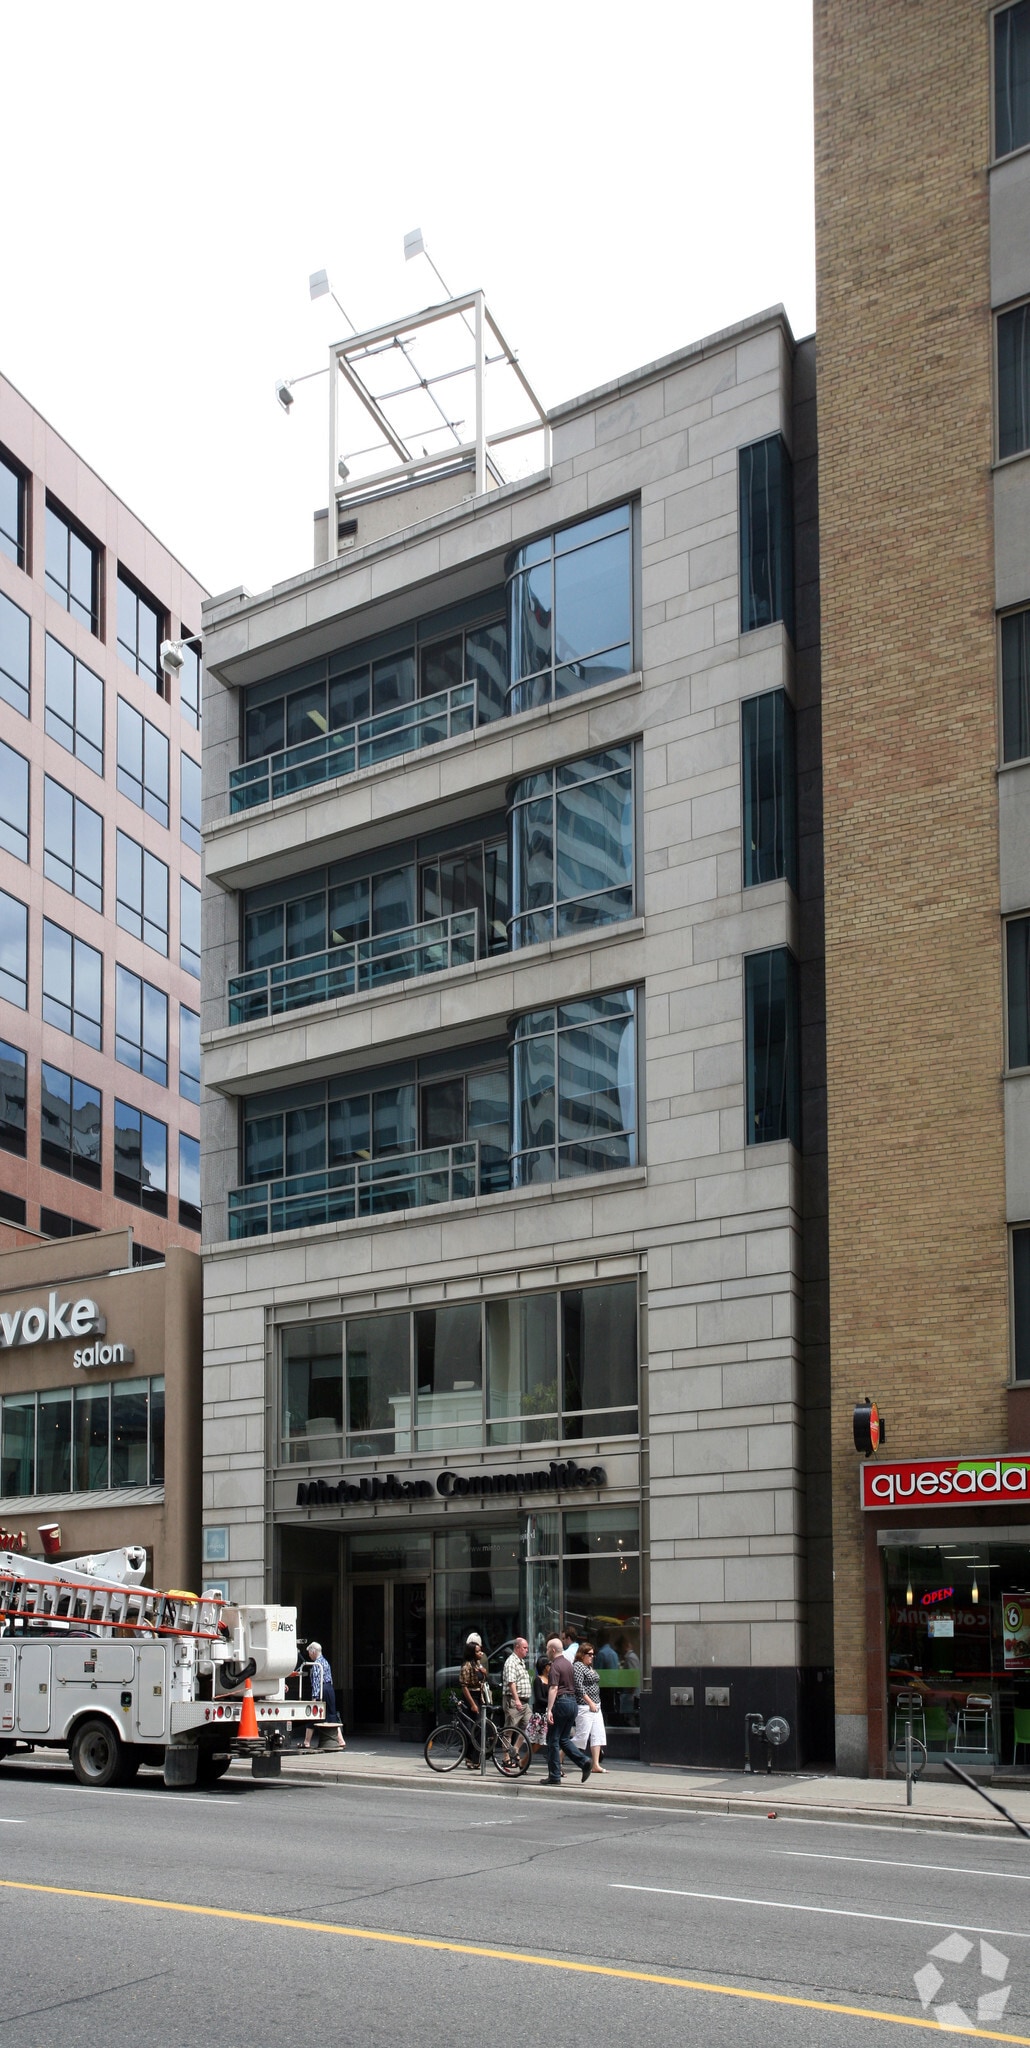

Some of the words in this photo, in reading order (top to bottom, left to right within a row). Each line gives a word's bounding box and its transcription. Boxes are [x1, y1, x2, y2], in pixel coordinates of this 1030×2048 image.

[0, 1292, 98, 1345] voke
[73, 1341, 124, 1368] salon
[436, 1460, 607, 1497] Communities
[871, 1461, 1027, 1504] quesada
[922, 1587, 953, 1605] OPEN
[278, 1621, 294, 1632] Altec
